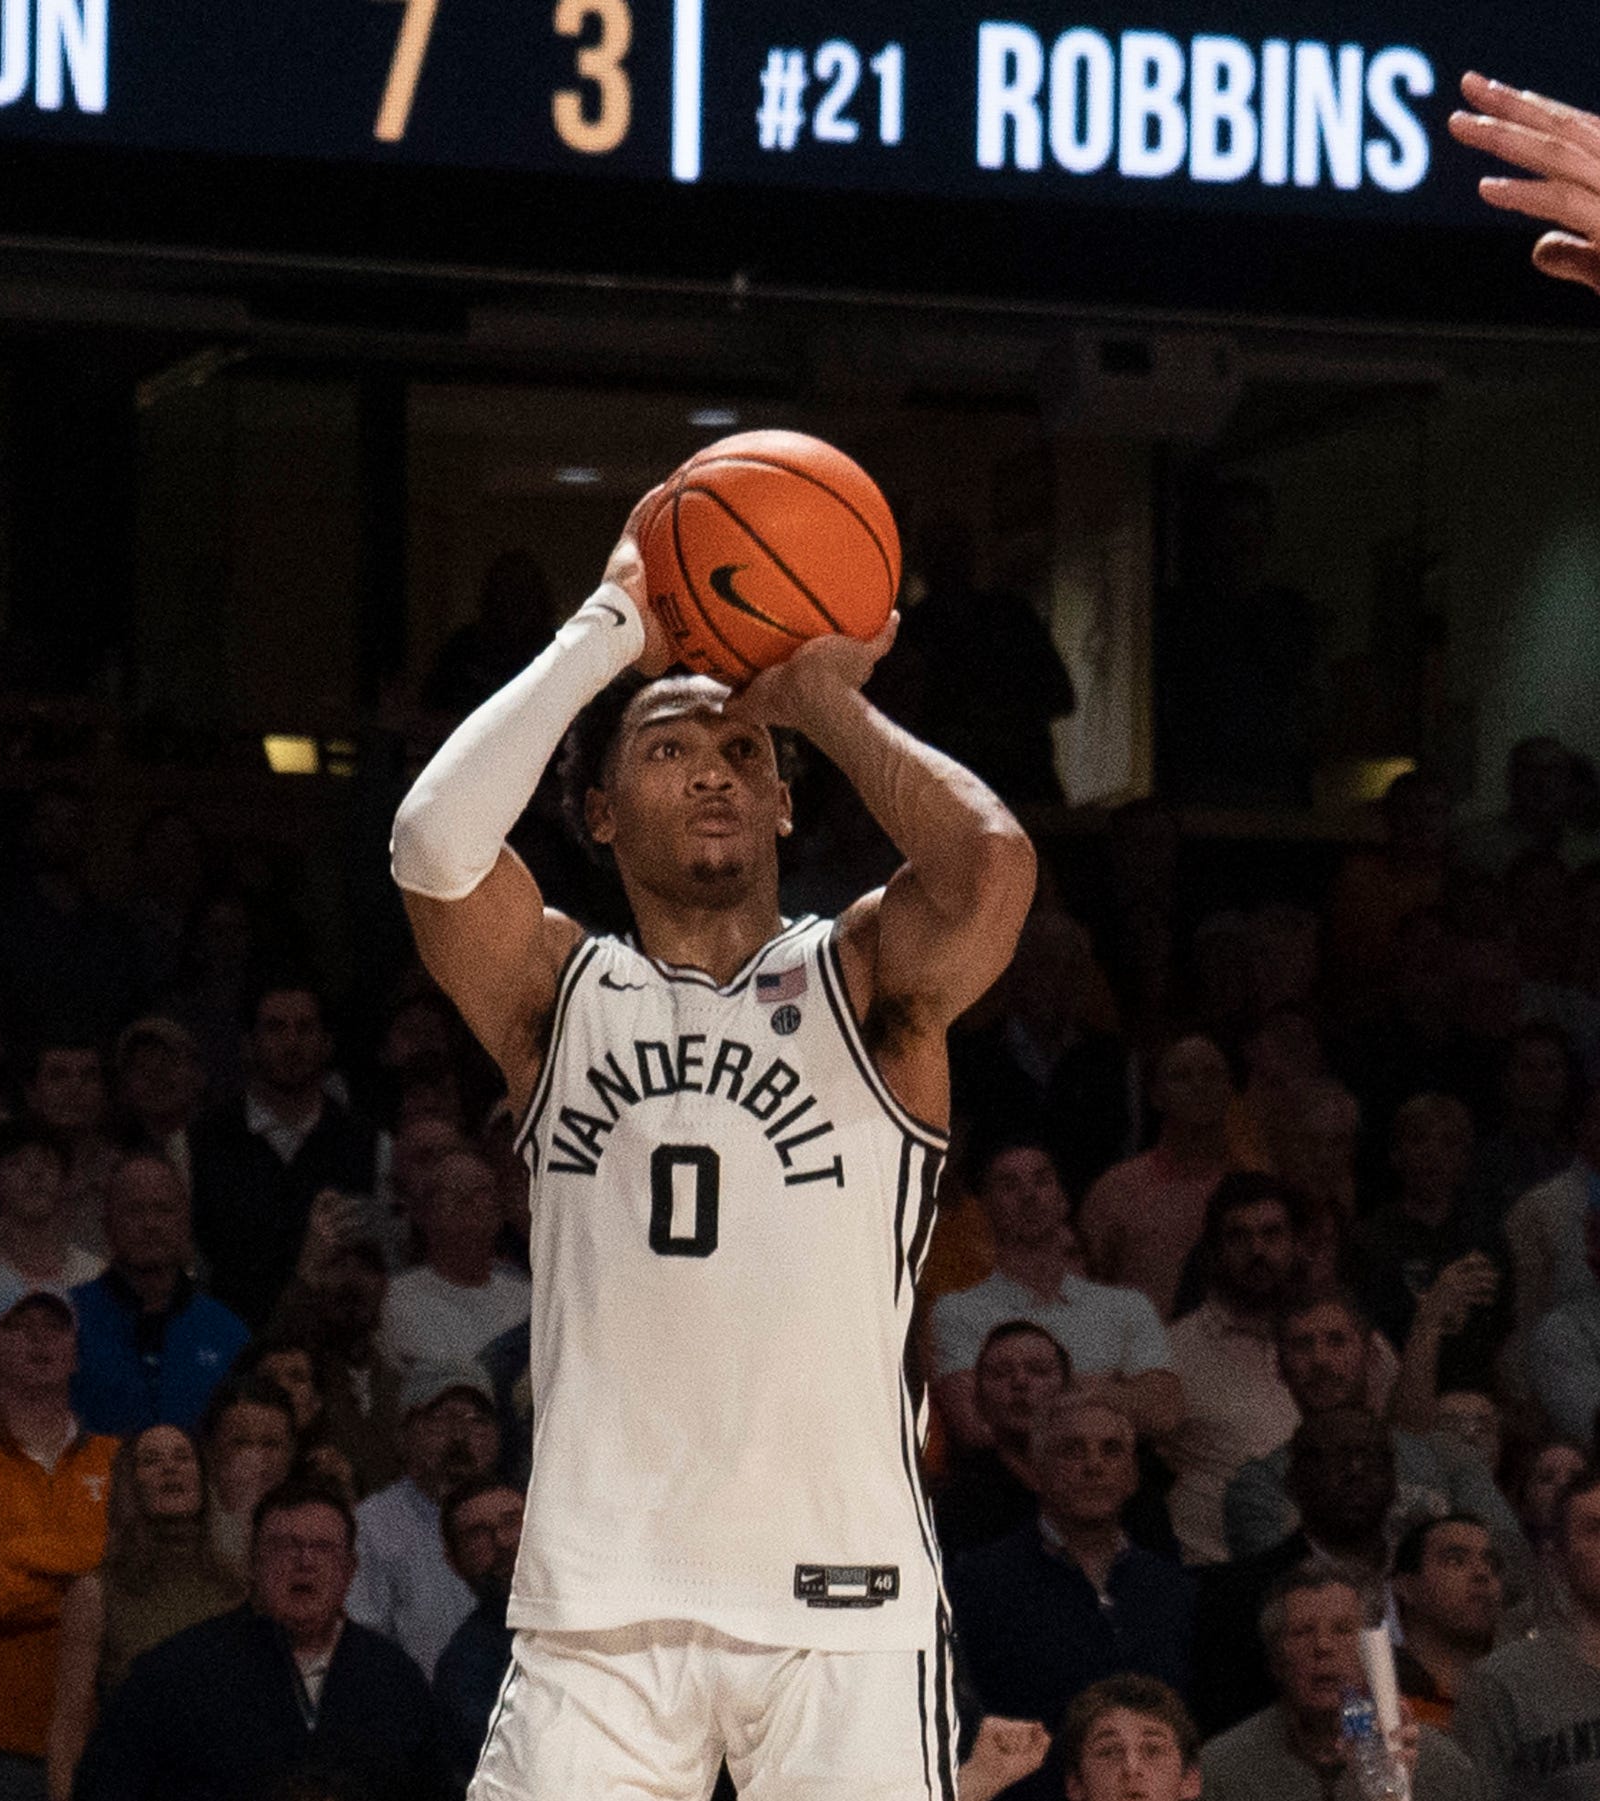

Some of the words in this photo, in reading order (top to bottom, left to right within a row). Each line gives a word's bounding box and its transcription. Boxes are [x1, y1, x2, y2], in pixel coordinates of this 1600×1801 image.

[553, 0, 634, 154] 3
[756, 42, 904, 152] #21
[975, 20, 1436, 194] ROBBINS
[547, 1034, 845, 1190] VANDERBILT
[649, 1143, 721, 1258] 0
